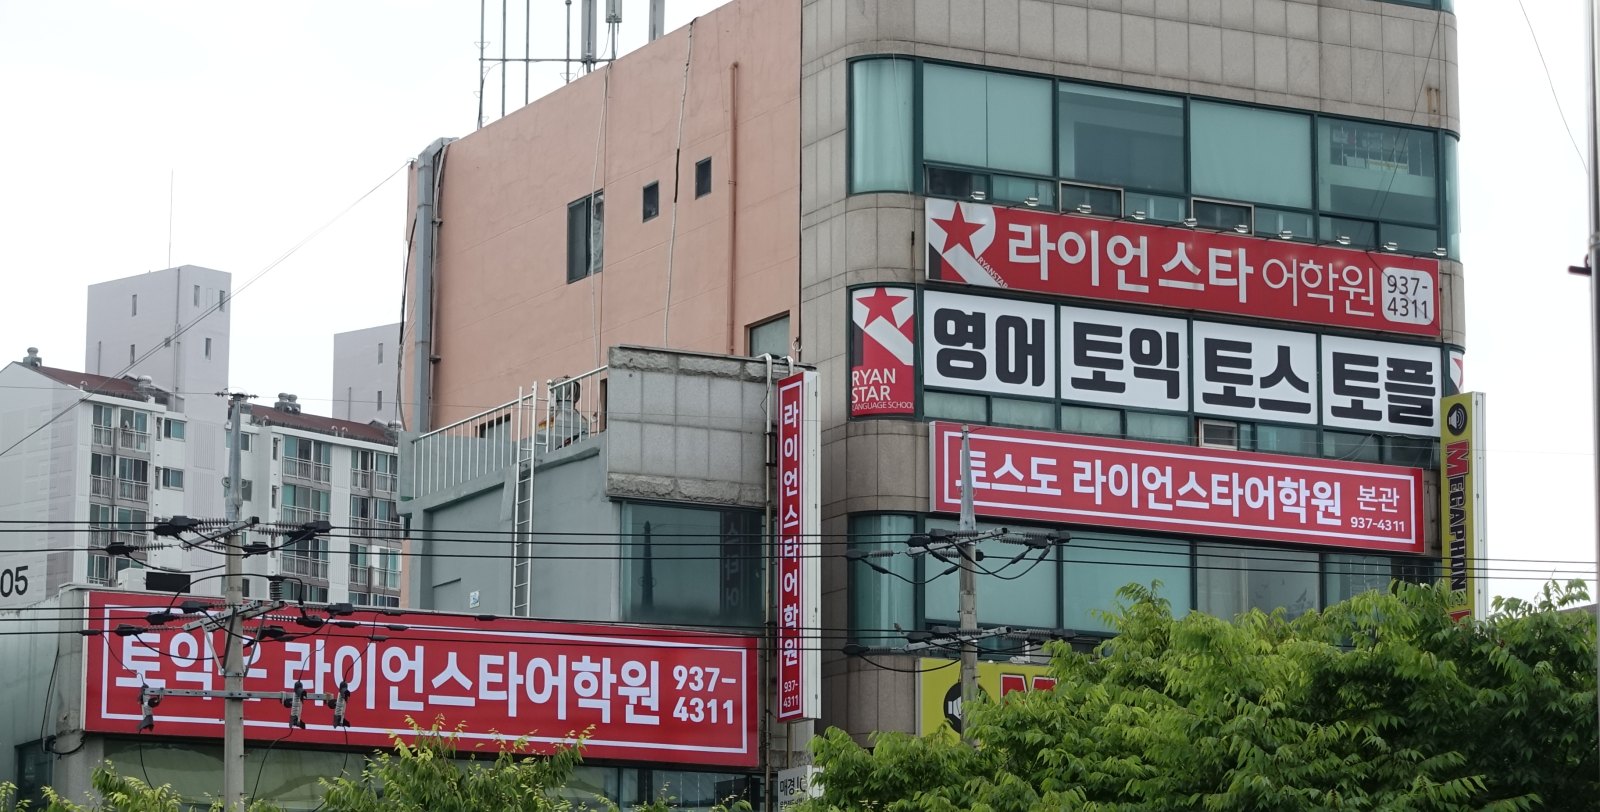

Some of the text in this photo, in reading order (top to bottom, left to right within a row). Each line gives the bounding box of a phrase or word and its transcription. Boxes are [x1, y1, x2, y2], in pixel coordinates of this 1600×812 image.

[977, 256, 1009, 288] RYANSTAR
[1008, 222, 1375, 317] 라이언스타 어학원
[1386, 274, 1429, 296] 937-
[1387, 296, 1430, 320] 4311
[851, 368, 896, 387] RYAN
[933, 306, 1436, 428] 영어 토익 토스 토플
[851, 385, 891, 404] STAR
[888, 401, 915, 410] SCHOOL
[955, 449, 1400, 528] 토스도 라이언스타어학원 본관
[783, 401, 799, 667] 라이언스타어학원
[1350, 516, 1406, 532] 937-4311
[284, 638, 660, 726] 라이언스타어학원
[672, 665, 737, 692] 937-
[783, 680, 799, 692] 937-
[672, 696, 735, 724] 4311
[783, 695, 799, 708] 4311
